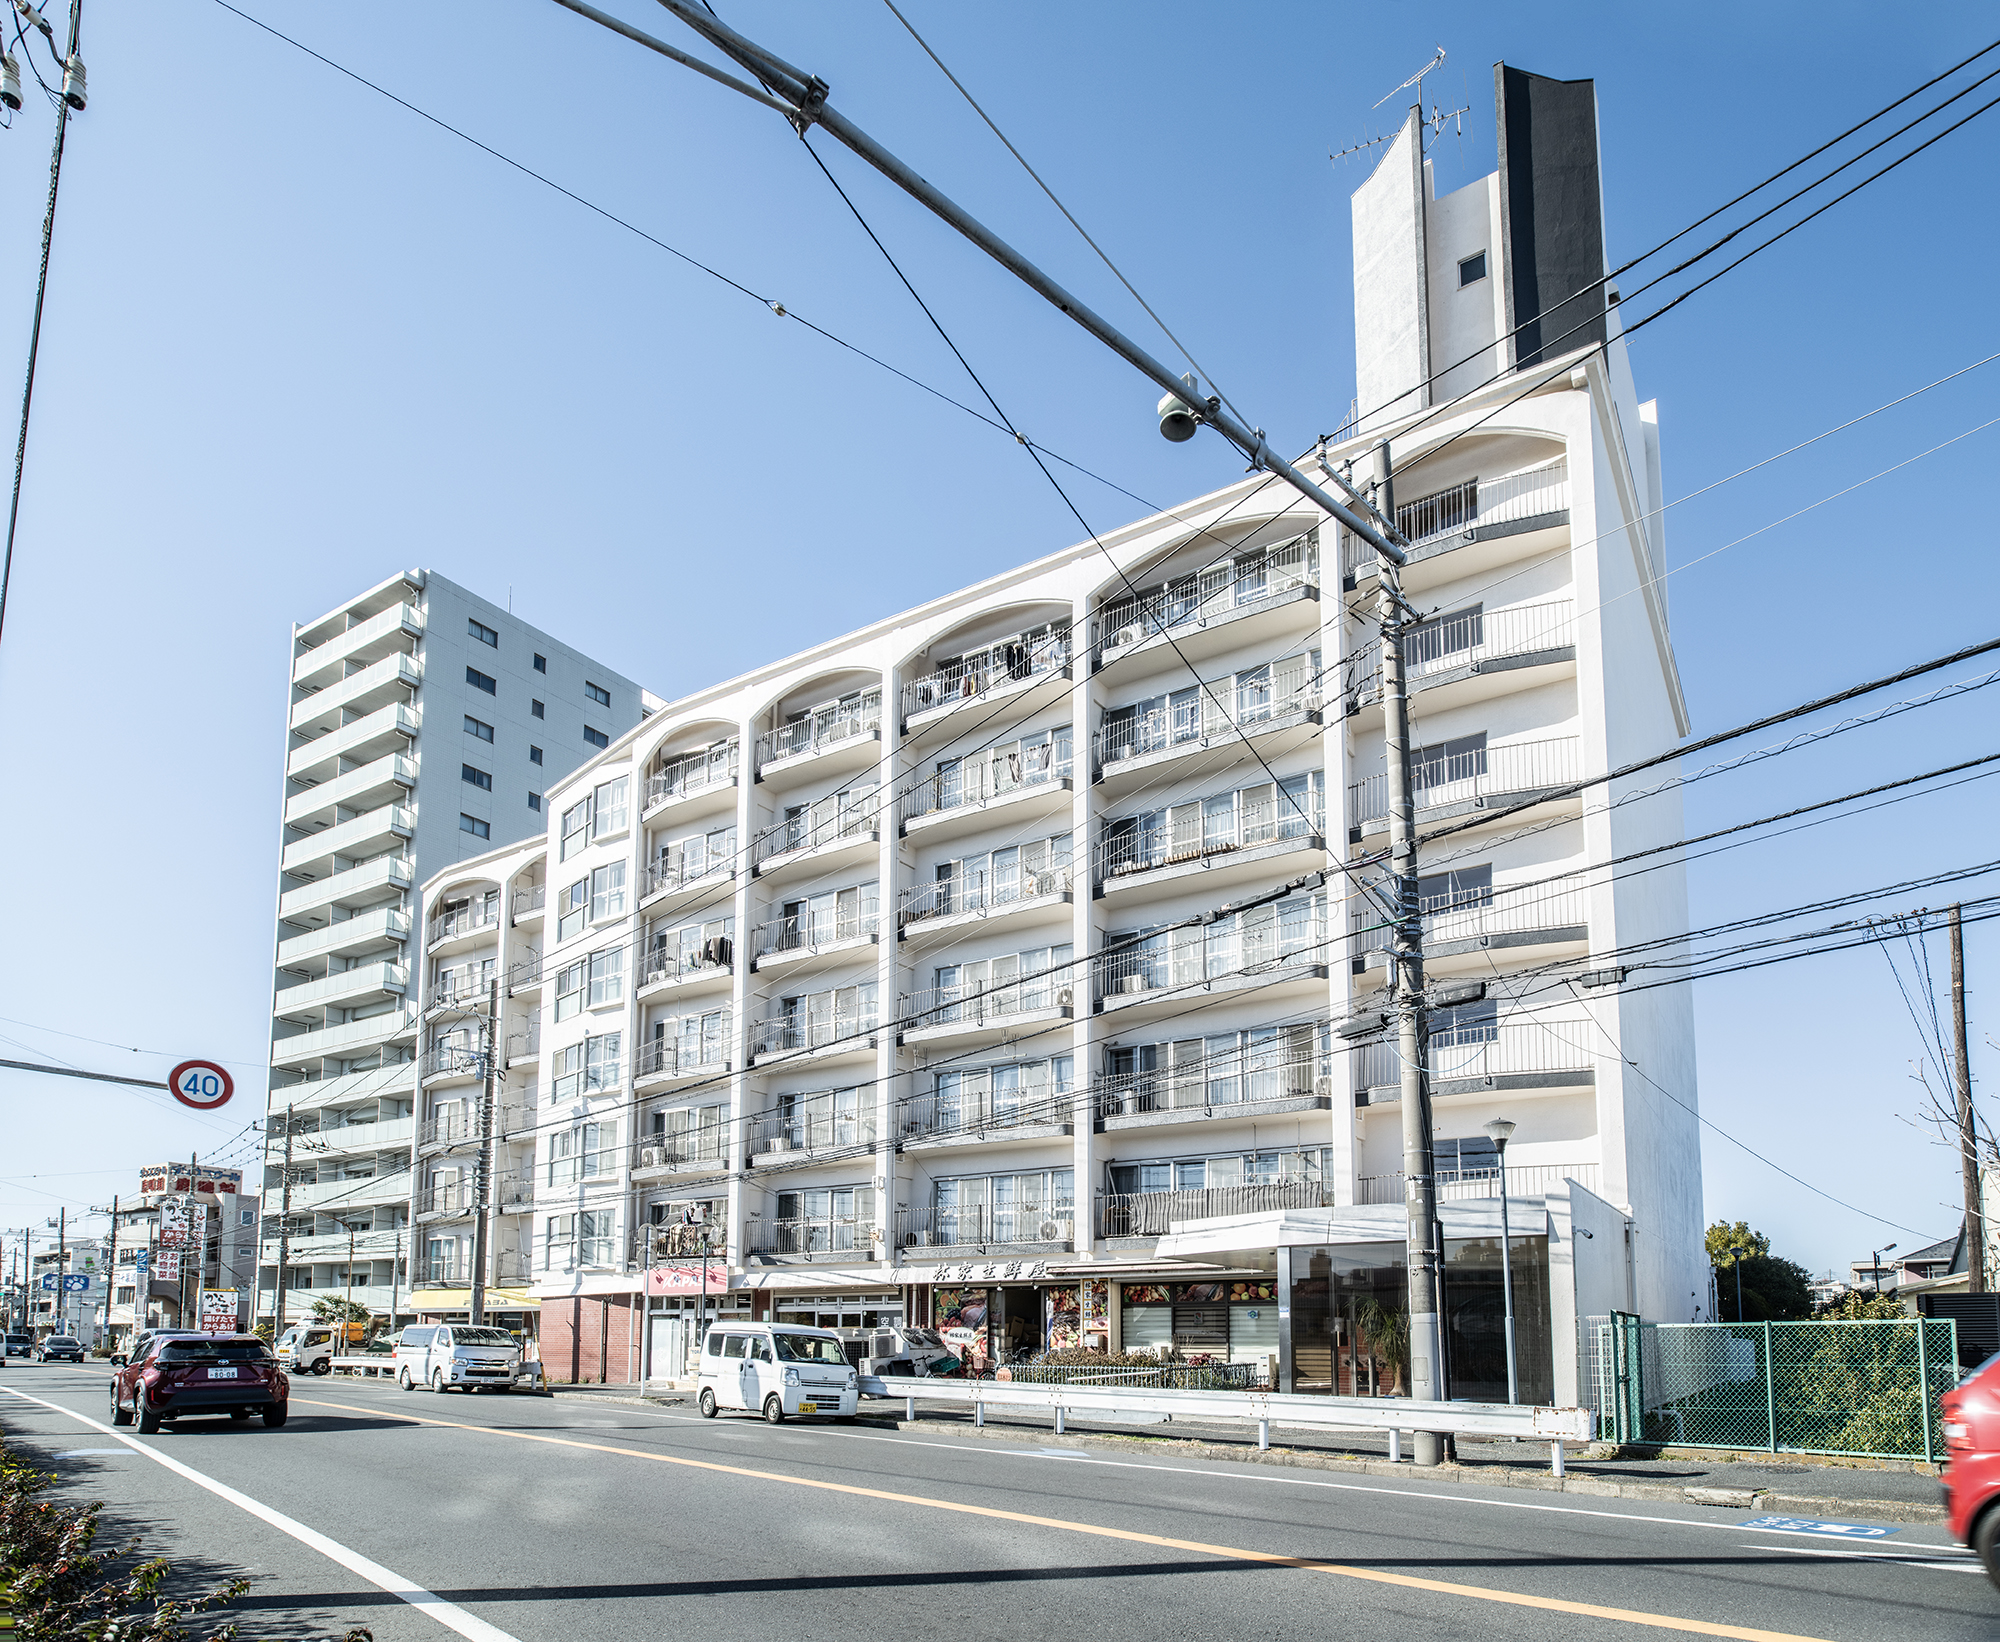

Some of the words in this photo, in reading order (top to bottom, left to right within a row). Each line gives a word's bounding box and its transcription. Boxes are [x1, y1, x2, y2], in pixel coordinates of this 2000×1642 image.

[183, 1073, 219, 1097] 40
[158, 1252, 169, 1278] お惣菜
[168, 1252, 178, 1279] お弁当
[933, 1260, 1046, 1281] 林家生鮮屋
[203, 1315, 236, 1323] 揚げたて
